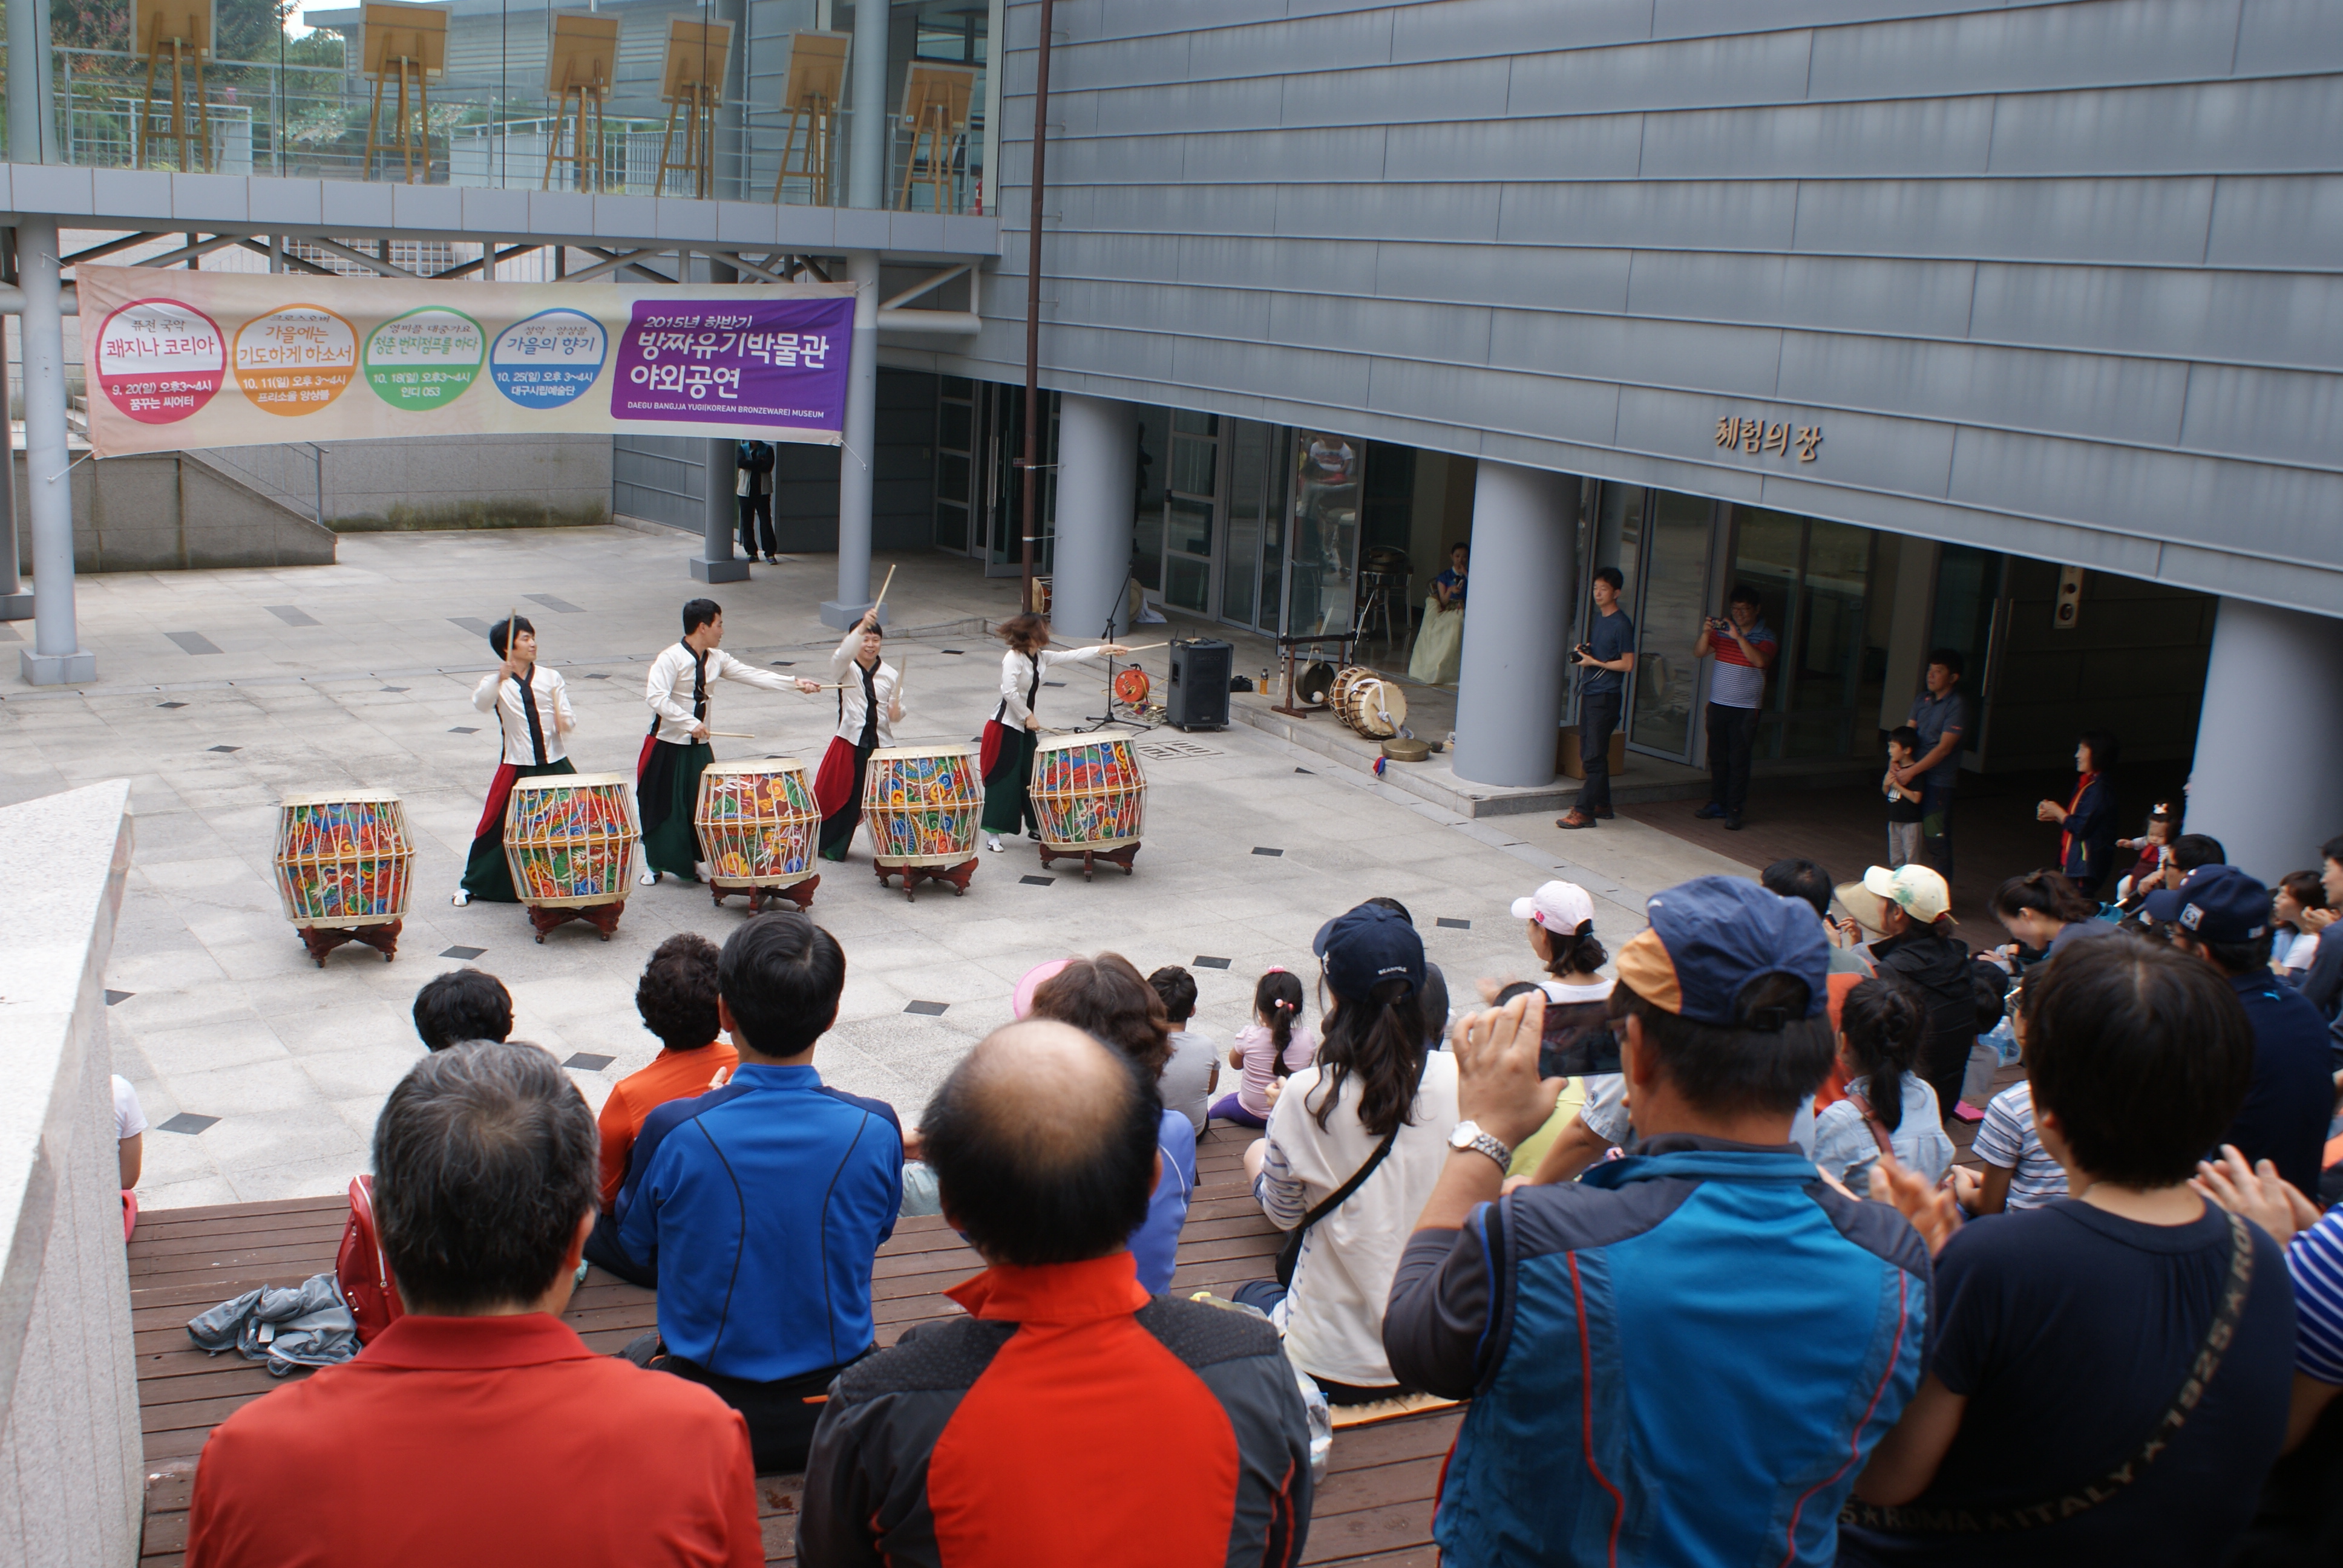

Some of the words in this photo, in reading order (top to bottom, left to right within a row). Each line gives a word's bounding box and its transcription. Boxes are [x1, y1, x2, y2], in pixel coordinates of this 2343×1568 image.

[131, 319, 157, 333] 퓨전
[160, 319, 186, 332] 국악
[270, 315, 330, 323] 크로스오버
[643, 315, 701, 328] 2015년
[704, 315, 753, 330] 하반기
[265, 325, 329, 344] 가을에는
[389, 324, 424, 334] 영피플
[427, 324, 471, 334] 대중가요
[525, 326, 546, 336] 성악
[556, 326, 589, 336] 앙상블
[106, 337, 160, 358] 쾌지나
[163, 335, 215, 356] 코리아
[374, 336, 396, 354] 청춘
[399, 336, 453, 355] 번지점프를
[454, 336, 478, 351] 하다
[507, 337, 557, 355] 가을의
[562, 337, 595, 355] 향기
[638, 332, 830, 369] 방짜유기박물관
[240, 345, 301, 364] 기도하게
[305, 345, 352, 363] 하소서
[243, 378, 258, 389] 10.
[261, 376, 289, 389] 11(일)
[292, 375, 313, 387] 오후
[315, 374, 346, 385] 3~4시
[391, 372, 419, 384] 18(일)
[513, 371, 540, 382] 25(일)
[543, 372, 562, 382] 오후
[563, 372, 593, 382] 3~4시
[630, 364, 741, 399] 야외공연
[126, 382, 157, 394] 20(일)
[401, 387, 420, 397] 인디
[422, 387, 441, 397] 053
[511, 385, 576, 396] 대구시립예술단
[129, 397, 161, 411] 꿈꾸는
[163, 395, 194, 408] 씨어터
[257, 391, 297, 402] 프리소울
[300, 390, 330, 401] 앙상블
[628, 401, 652, 410] DAEGU
[654, 402, 686, 410] BANGJJA
[792, 409, 824, 419] MUSEUM
[1884, 1506, 1983, 1534] ROMA
[2011, 1461, 2136, 1530] ITALY
